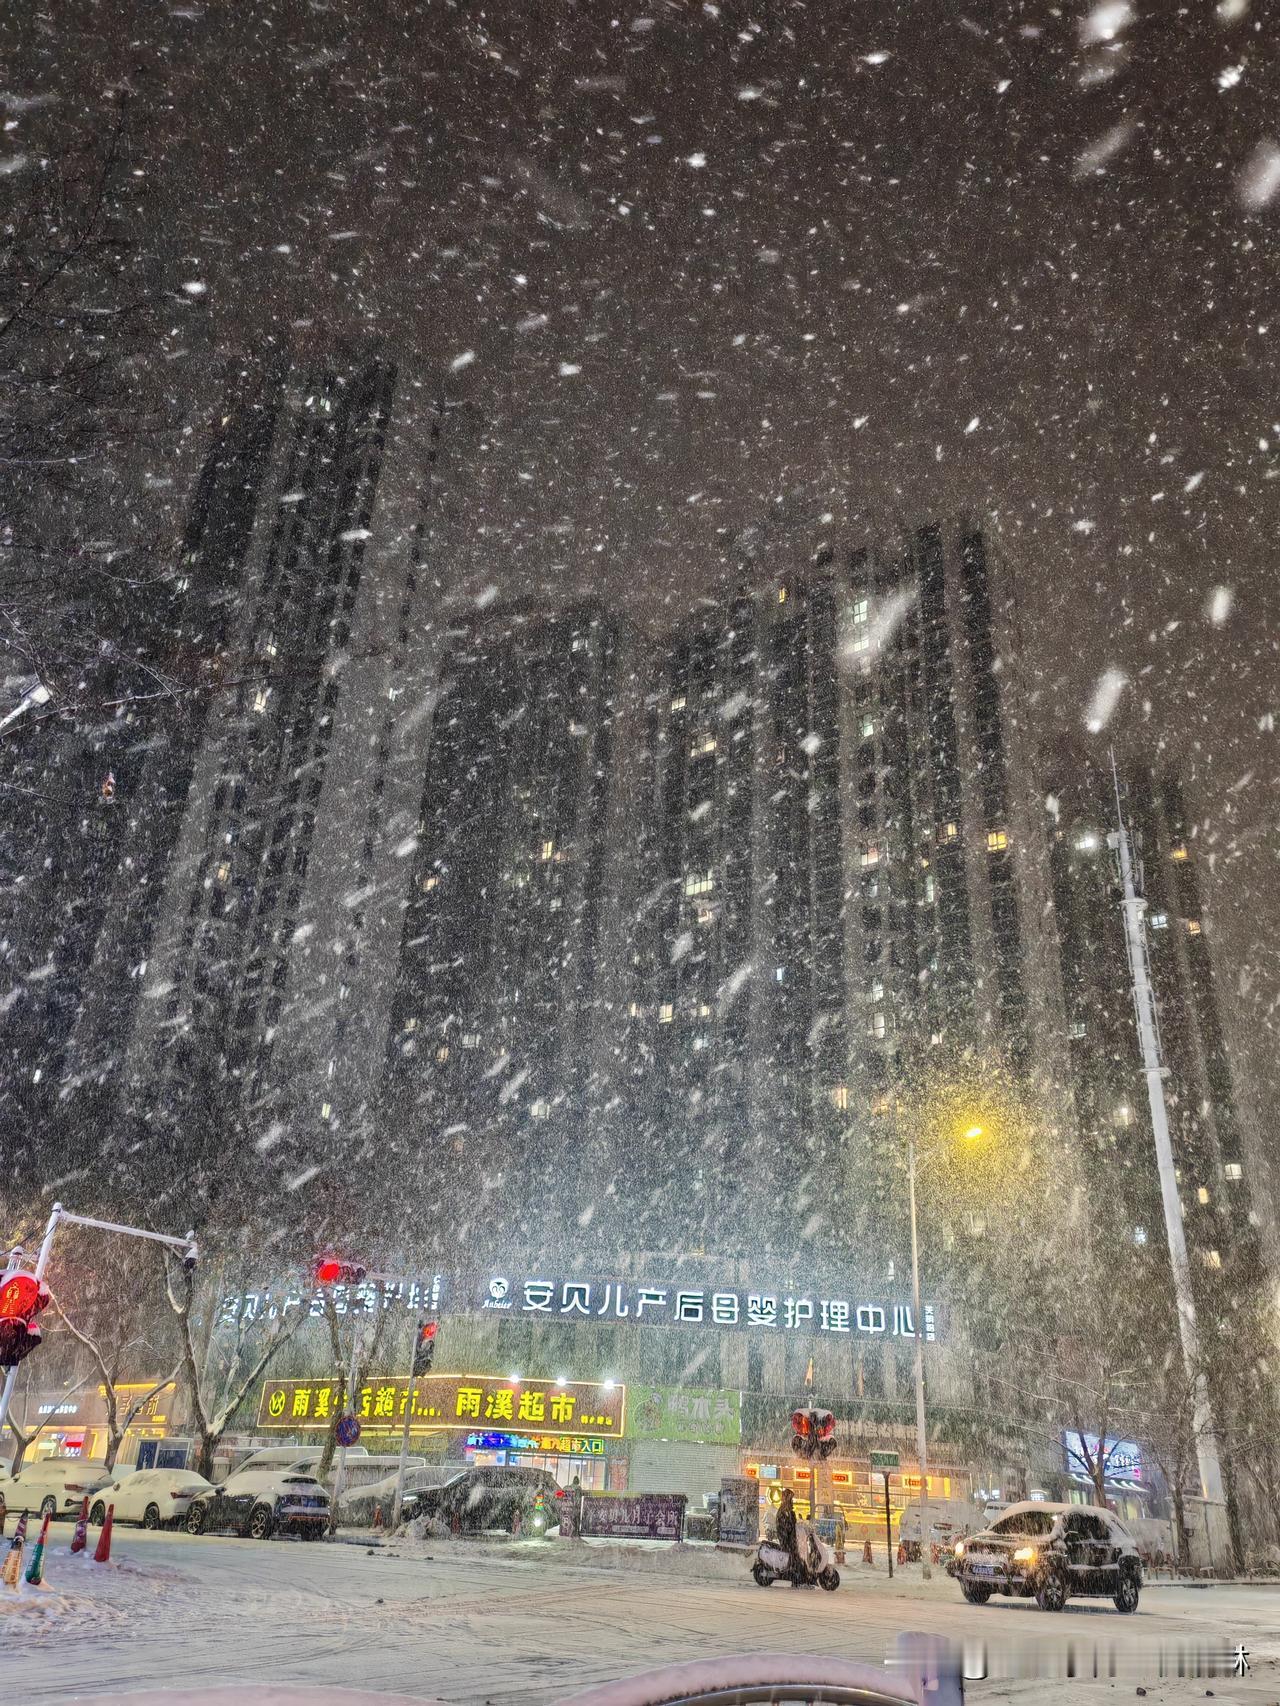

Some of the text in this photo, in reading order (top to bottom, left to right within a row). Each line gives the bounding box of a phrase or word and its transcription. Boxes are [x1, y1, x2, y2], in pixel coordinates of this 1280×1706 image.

[523, 1280, 922, 1338] 安贝儿产后母婴护理中心
[455, 1387, 576, 1423] 雨溪超市
[560, 1438, 602, 1454] 超市入口
